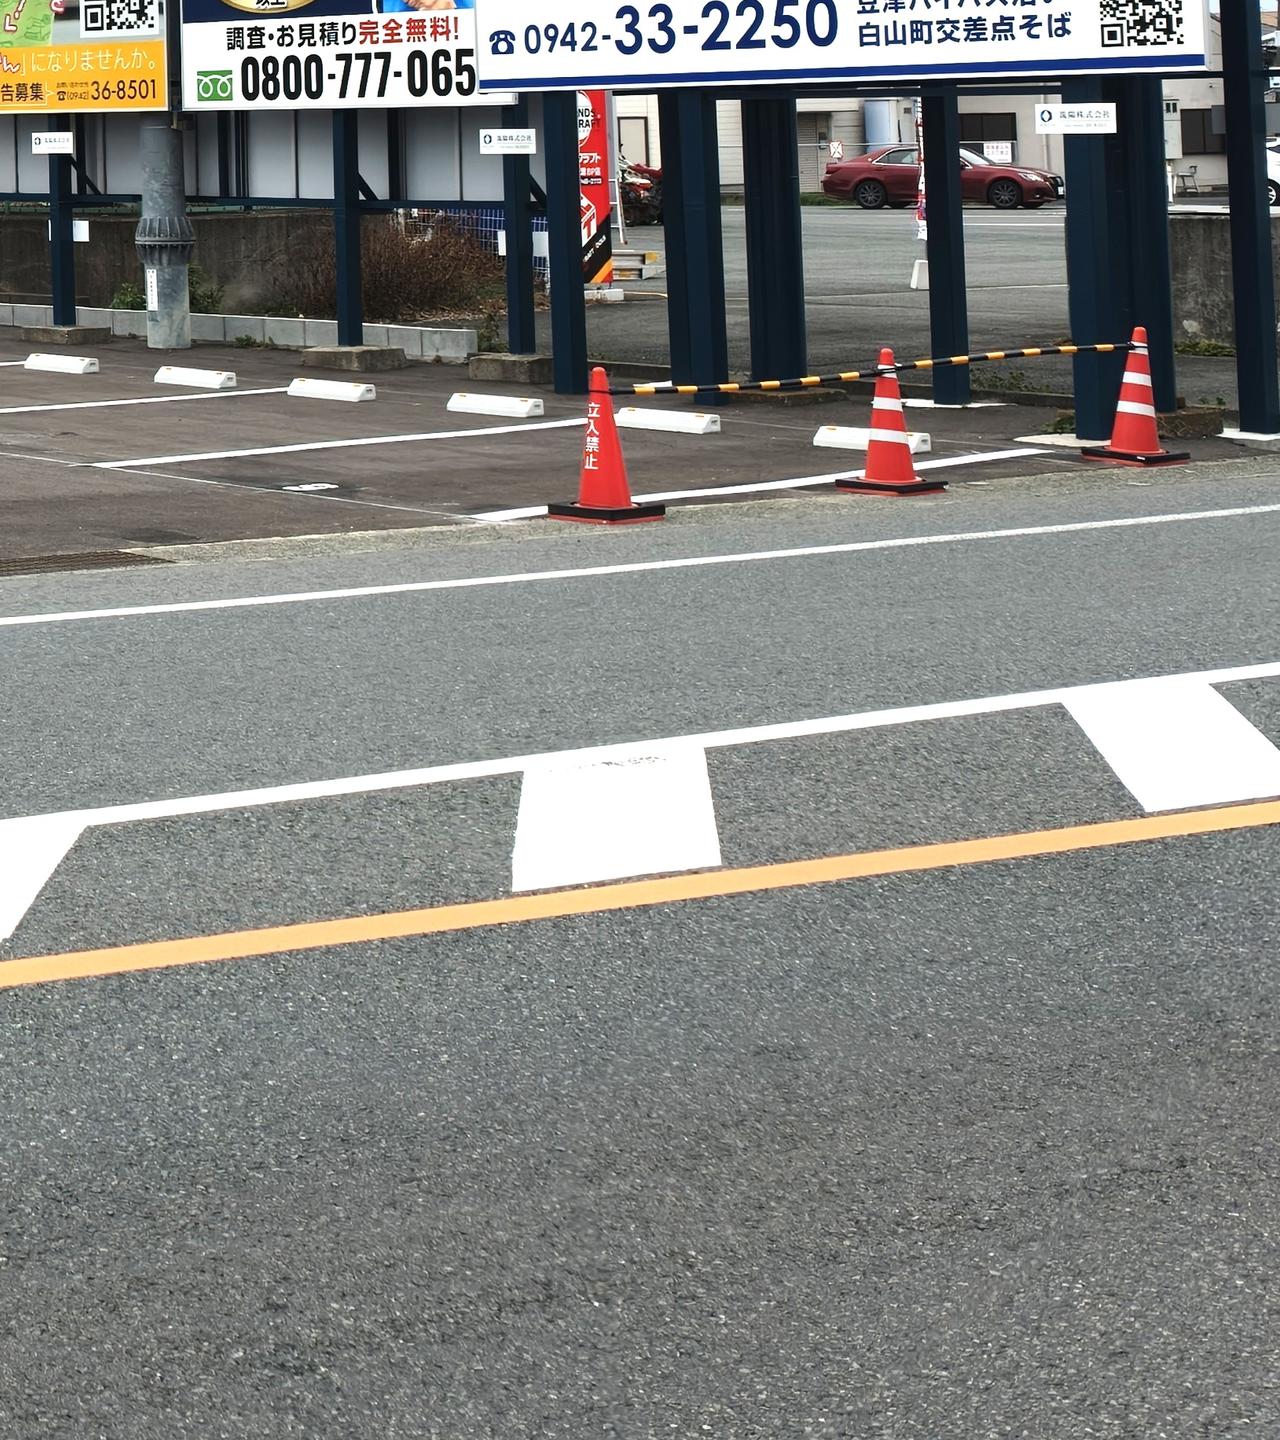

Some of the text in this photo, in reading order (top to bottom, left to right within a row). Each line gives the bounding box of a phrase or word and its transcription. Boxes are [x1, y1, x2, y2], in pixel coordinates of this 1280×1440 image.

[858, 11, 1072, 48] 白山町交差点そば
[91, 79, 157, 101] 36-8501
[240, 48, 480, 102] 0800-777-065
[578, 119, 601, 128] RAFT
[584, 402, 601, 469] 立入禁止
